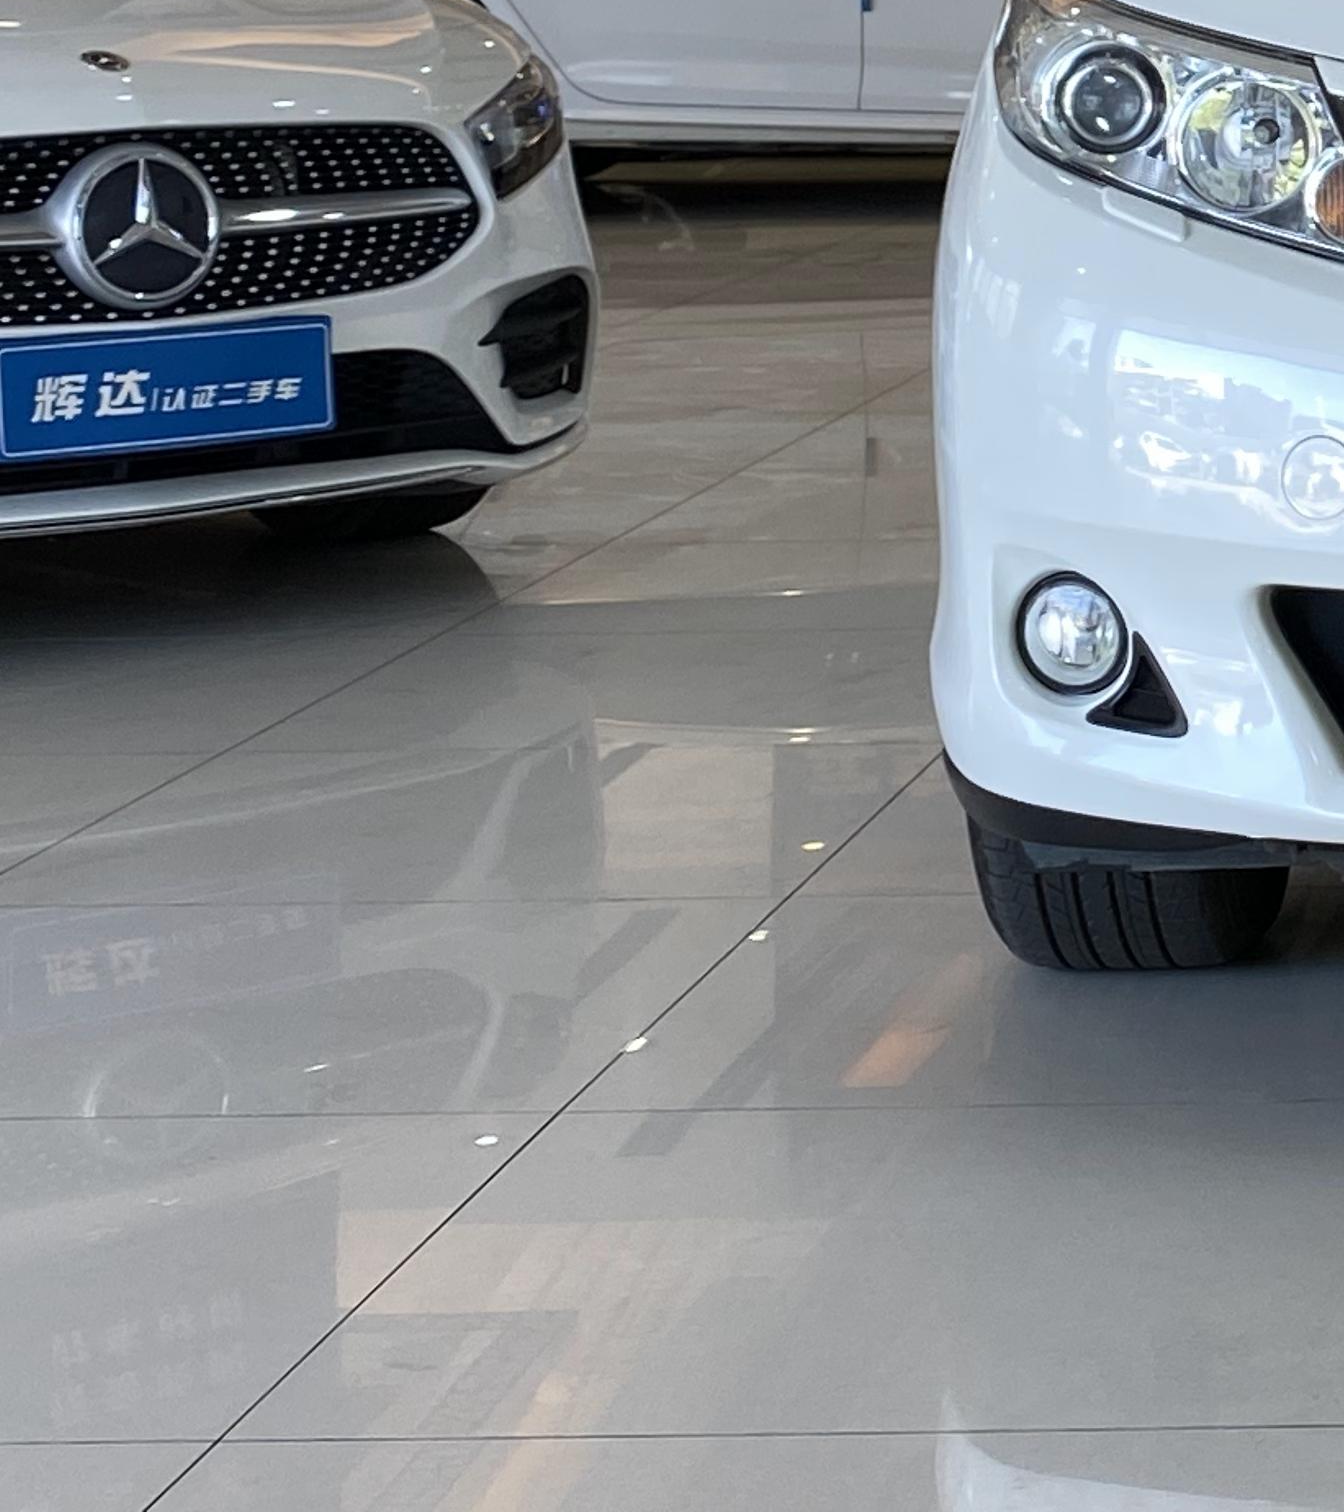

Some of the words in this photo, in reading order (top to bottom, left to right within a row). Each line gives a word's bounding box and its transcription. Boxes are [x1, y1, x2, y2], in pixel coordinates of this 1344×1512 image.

[31, 368, 151, 423] 辉达
[161, 376, 303, 412] 认证二手车
